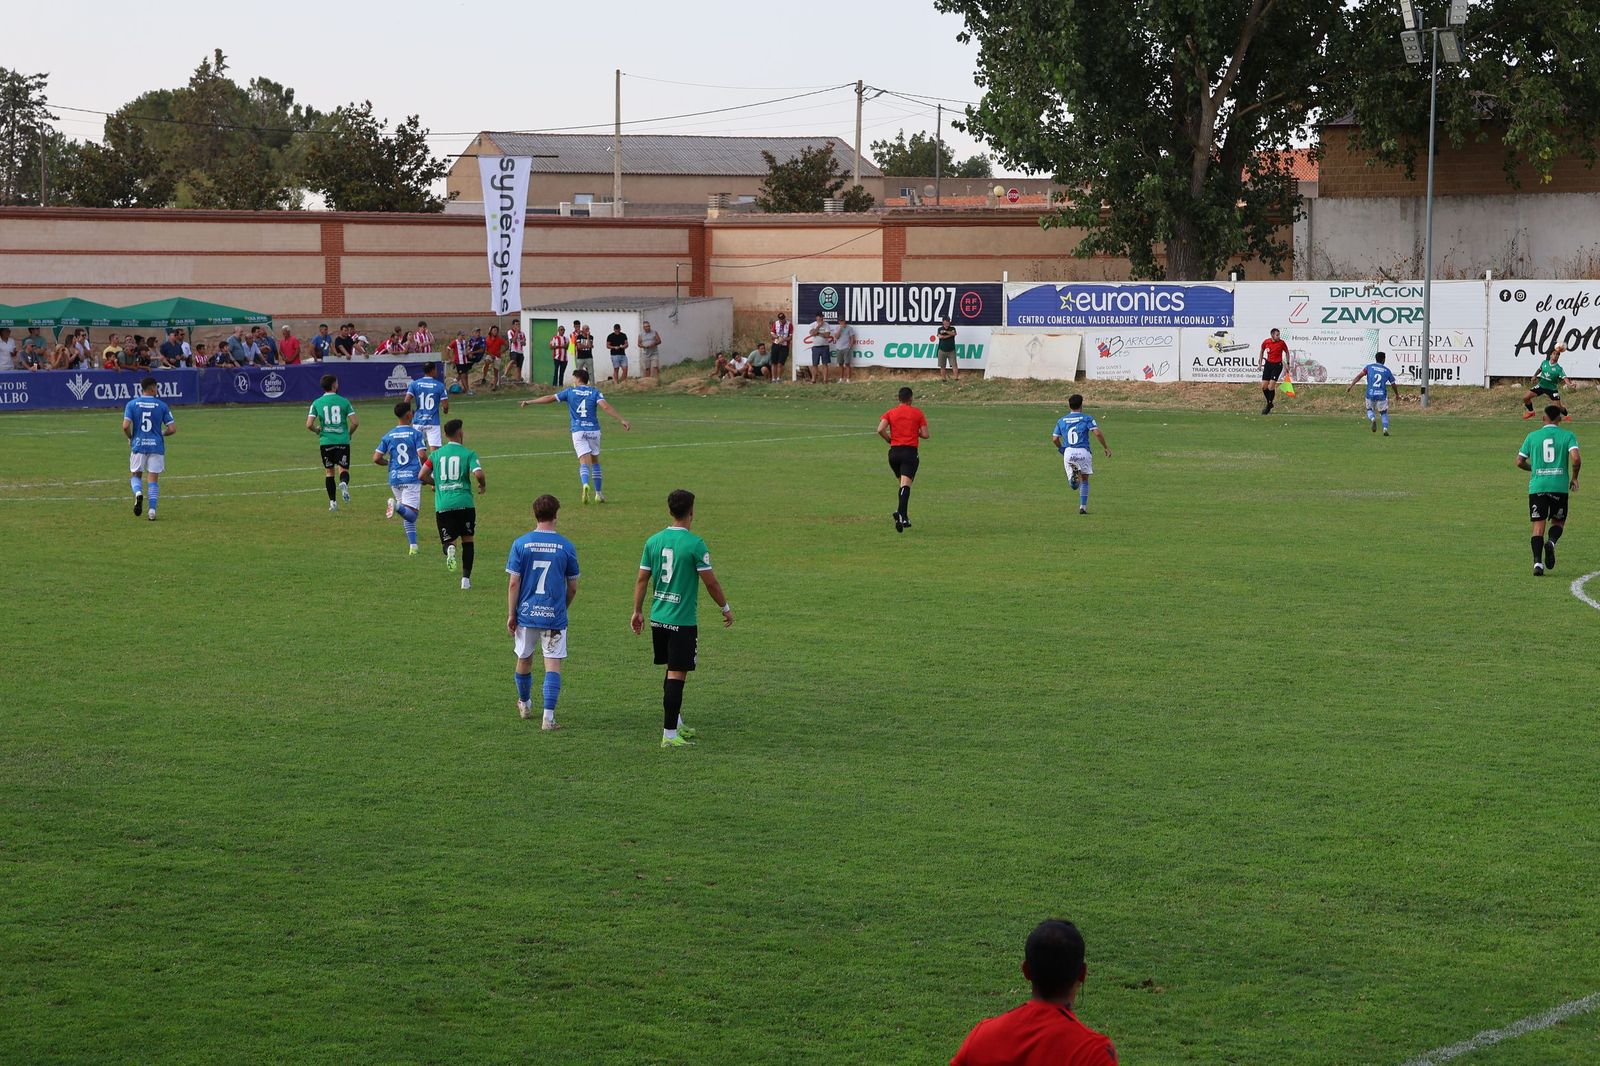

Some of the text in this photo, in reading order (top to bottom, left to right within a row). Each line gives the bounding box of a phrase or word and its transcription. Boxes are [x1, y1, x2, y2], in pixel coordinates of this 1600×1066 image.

[845, 286, 956, 322] IMPULSO27
[1076, 286, 1184, 312] euronics
[1536, 294, 1552, 312] el
[1556, 290, 1590, 316] café
[1018, 315, 1044, 324] CENTRO
[1047, 315, 1086, 324] COMERCIAL
[1089, 315, 1138, 324] VALDERADUEY
[1141, 315, 1171, 326] (PUERTA
[1174, 315, 1215, 325] MCDONALD
[1193, 357, 1203, 366] A.
[1395, 353, 1468, 363] VILLRALBO
[1373, 373, 1382, 387] 2
[94, 382, 182, 400] CAJA RRAL
[419, 392, 435, 410] 16
[323, 405, 341, 425] 18
[576, 399, 587, 417] 4
[141, 412, 152, 432] 5
[1068, 426, 1078, 444] 6
[397, 443, 409, 465] 8
[1543, 438, 1555, 463] 6
[440, 456, 460, 480] 10
[662, 548, 673, 584] 3
[532, 560, 551, 594] 7
